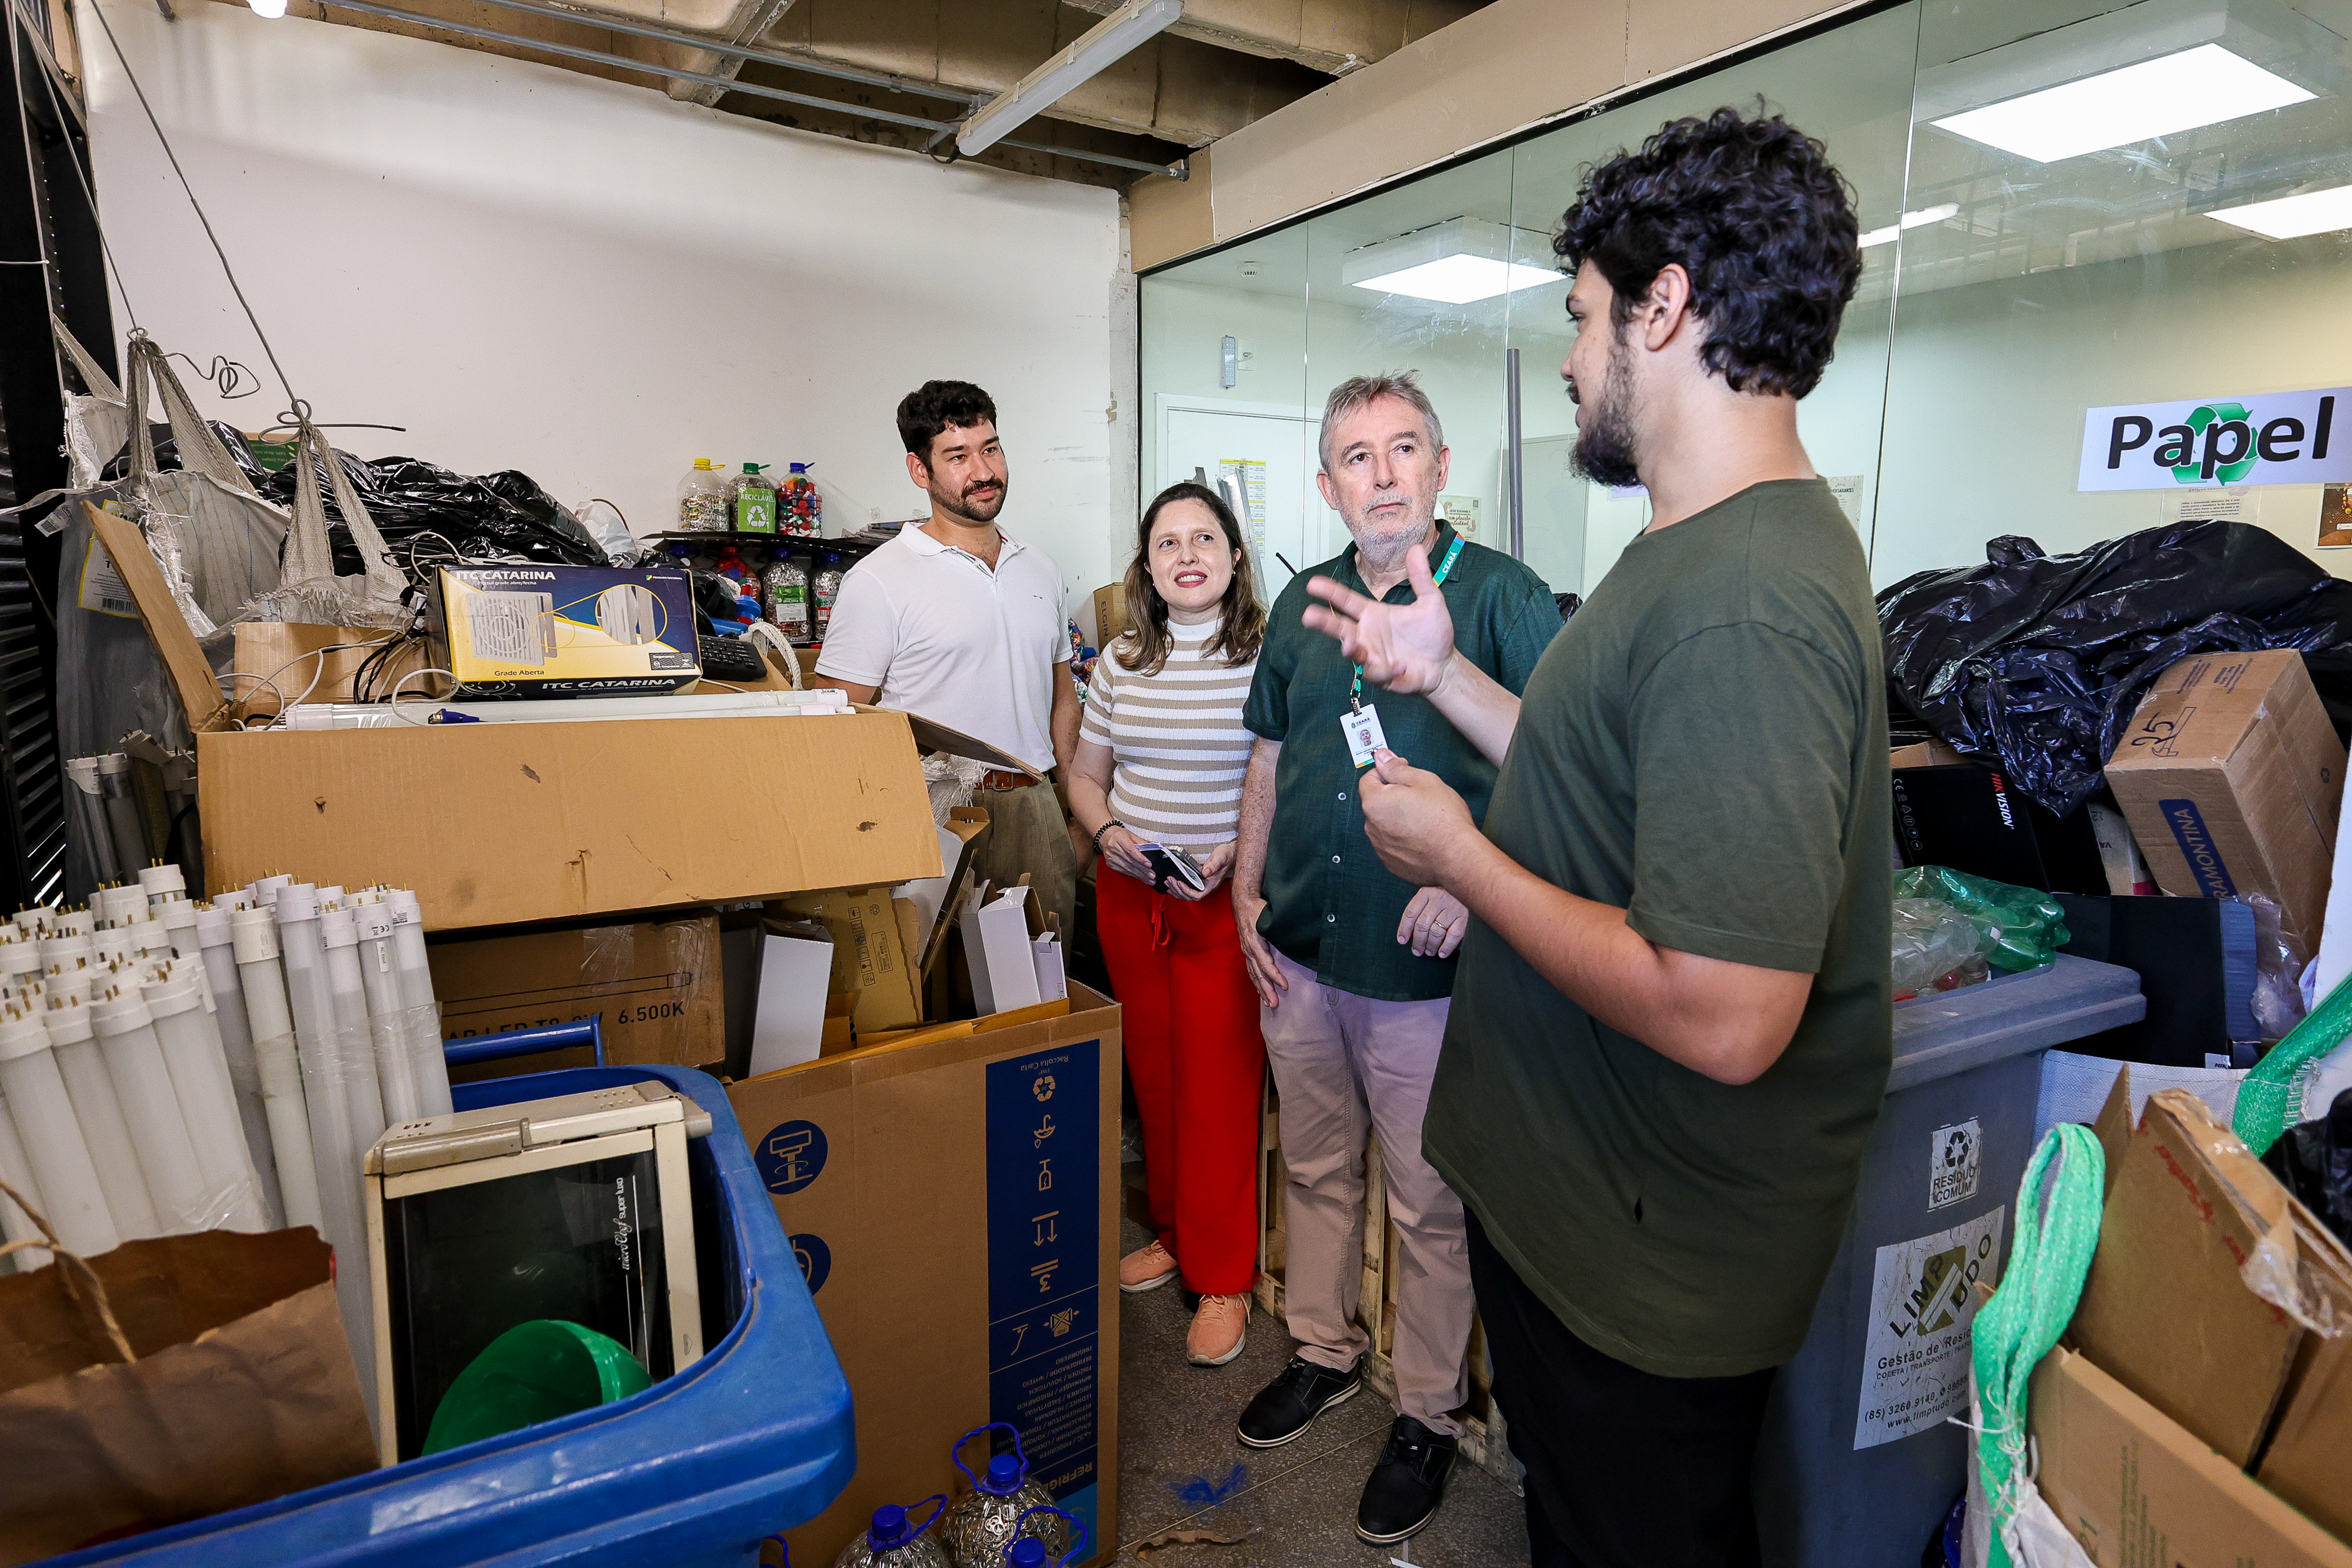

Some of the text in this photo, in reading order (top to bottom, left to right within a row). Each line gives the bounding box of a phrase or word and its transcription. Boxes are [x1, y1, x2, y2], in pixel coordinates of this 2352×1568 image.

[2107, 396, 2335, 479] Papel
[740, 494, 775, 502] RECICLÁVEL
[1442, 551, 1458, 574] CEARÁ
[456, 570, 556, 580] ITC CATARINA
[577, 679, 676, 688] CATARINA
[1355, 717, 1371, 726] CEARÁ
[1991, 772, 2014, 828] HIKVISION
[2173, 808, 2230, 898] RAMONTINA
[618, 1001, 685, 1024] 6.500K
[1020, 1054, 1069, 1071] Raccolta Carta
[1936, 1181, 1972, 1202] COMUM
[618, 1196, 627, 1219] super
[1876, 1368, 1905, 1380] COLETA
[1910, 1351, 1951, 1371] TRANSPORTE
[1877, 1350, 1923, 1370] Gestão
[1926, 1344, 1939, 1356] de
[1864, 1407, 1885, 1423] (85)
